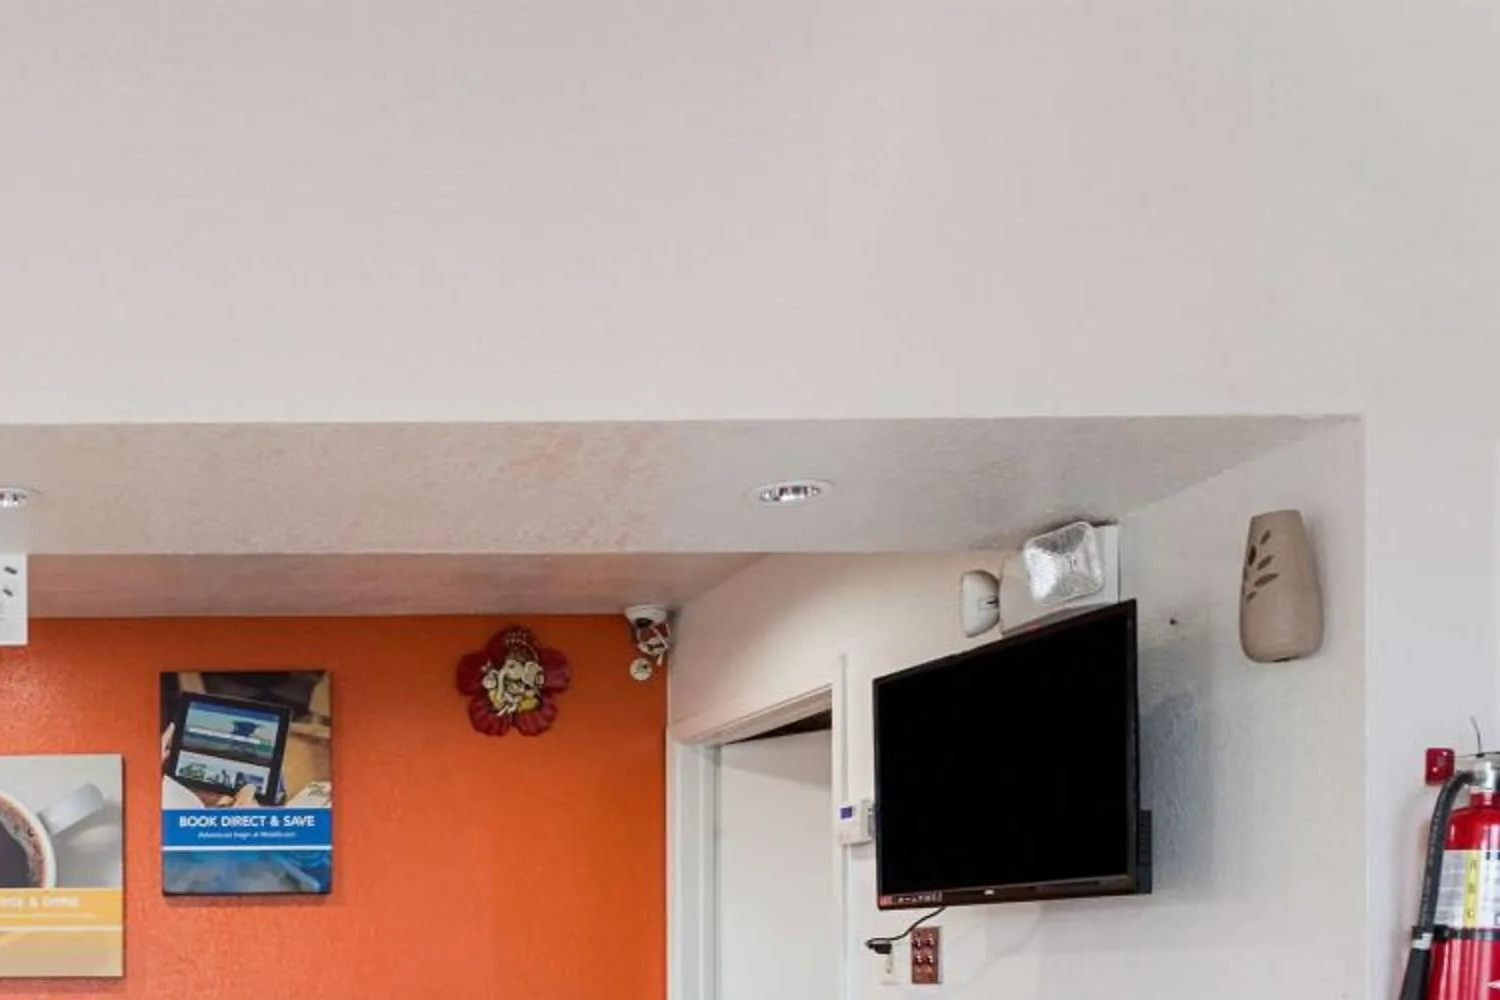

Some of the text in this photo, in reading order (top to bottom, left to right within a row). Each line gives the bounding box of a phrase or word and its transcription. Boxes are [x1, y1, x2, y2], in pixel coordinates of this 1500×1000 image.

[179, 815, 315, 827] BOOK DIRECT & SAVE
